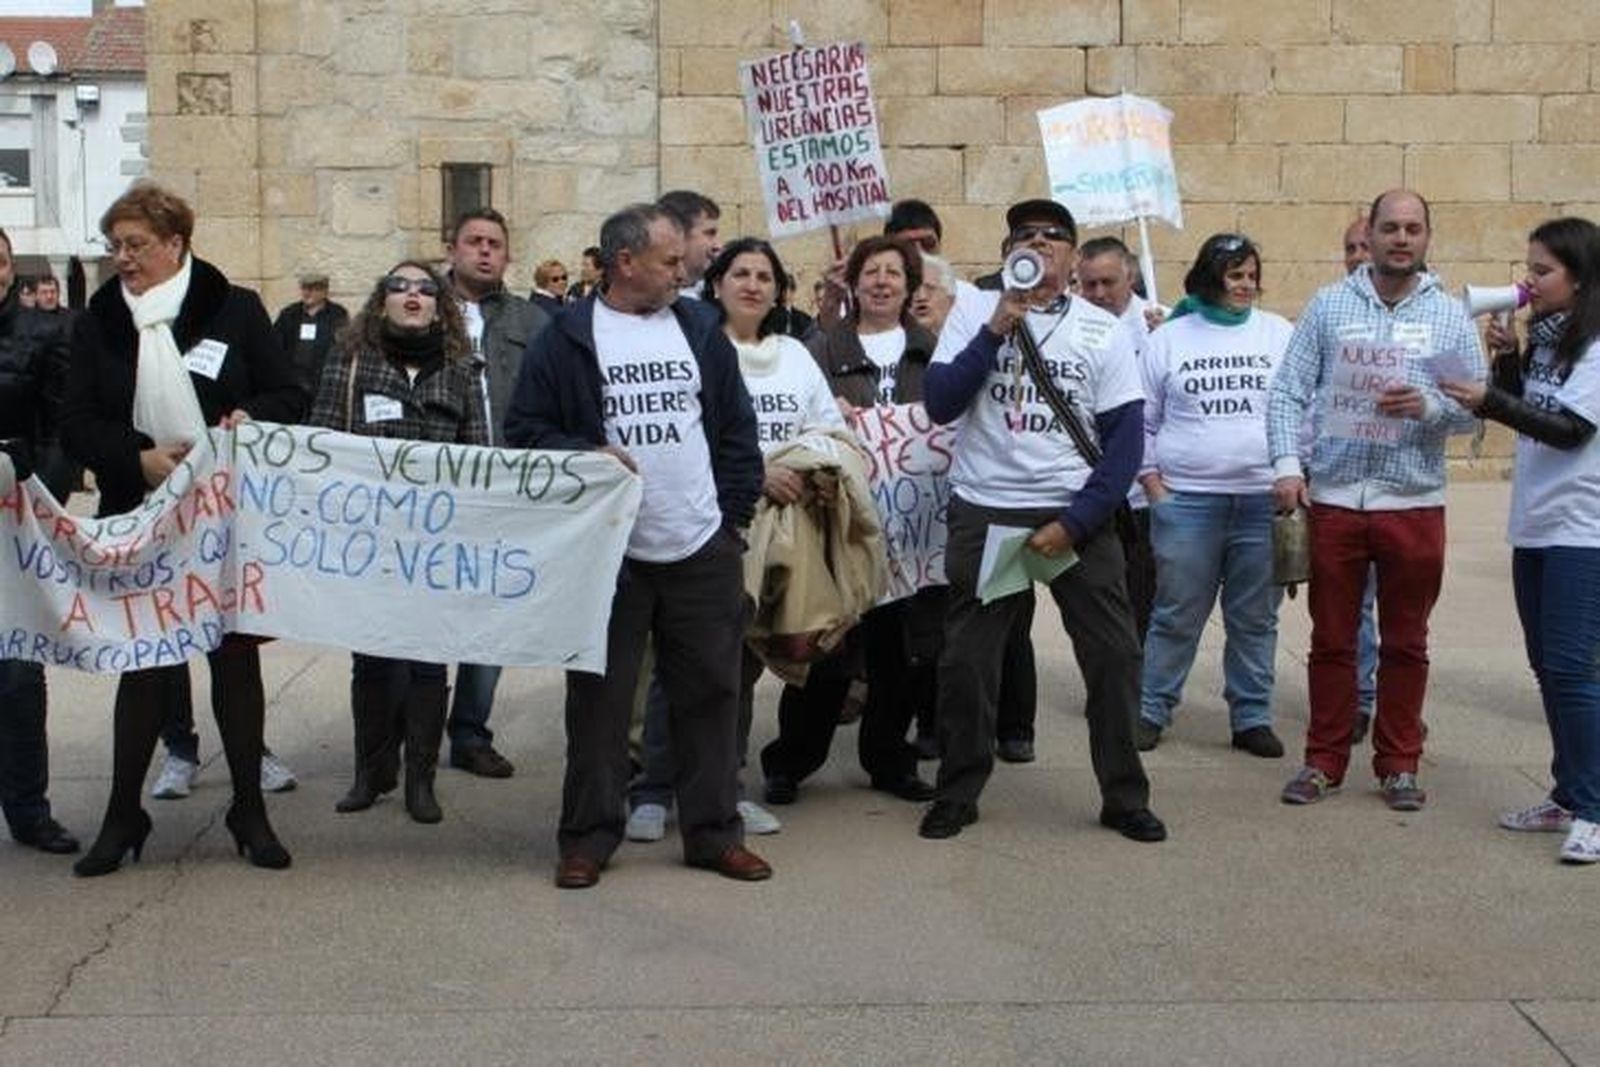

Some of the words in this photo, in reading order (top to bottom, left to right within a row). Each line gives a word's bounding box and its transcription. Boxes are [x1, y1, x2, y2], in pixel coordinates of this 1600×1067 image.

[758, 73, 869, 113] NUESTRAS
[761, 102, 872, 145] URGENCIAS
[768, 130, 871, 171] ESTAMOS
[777, 175, 791, 196] A
[803, 162, 843, 187] 100
[846, 157, 876, 181] Km
[812, 178, 890, 215] HOSPITAL
[1178, 355, 1272, 375] ARRIBES
[1184, 374, 1267, 395] QUIERE
[1199, 397, 1252, 415] VIDA
[617, 423, 681, 446] VIDA
[371, 438, 588, 505] VENIMOS
[61, 593, 94, 632] A
